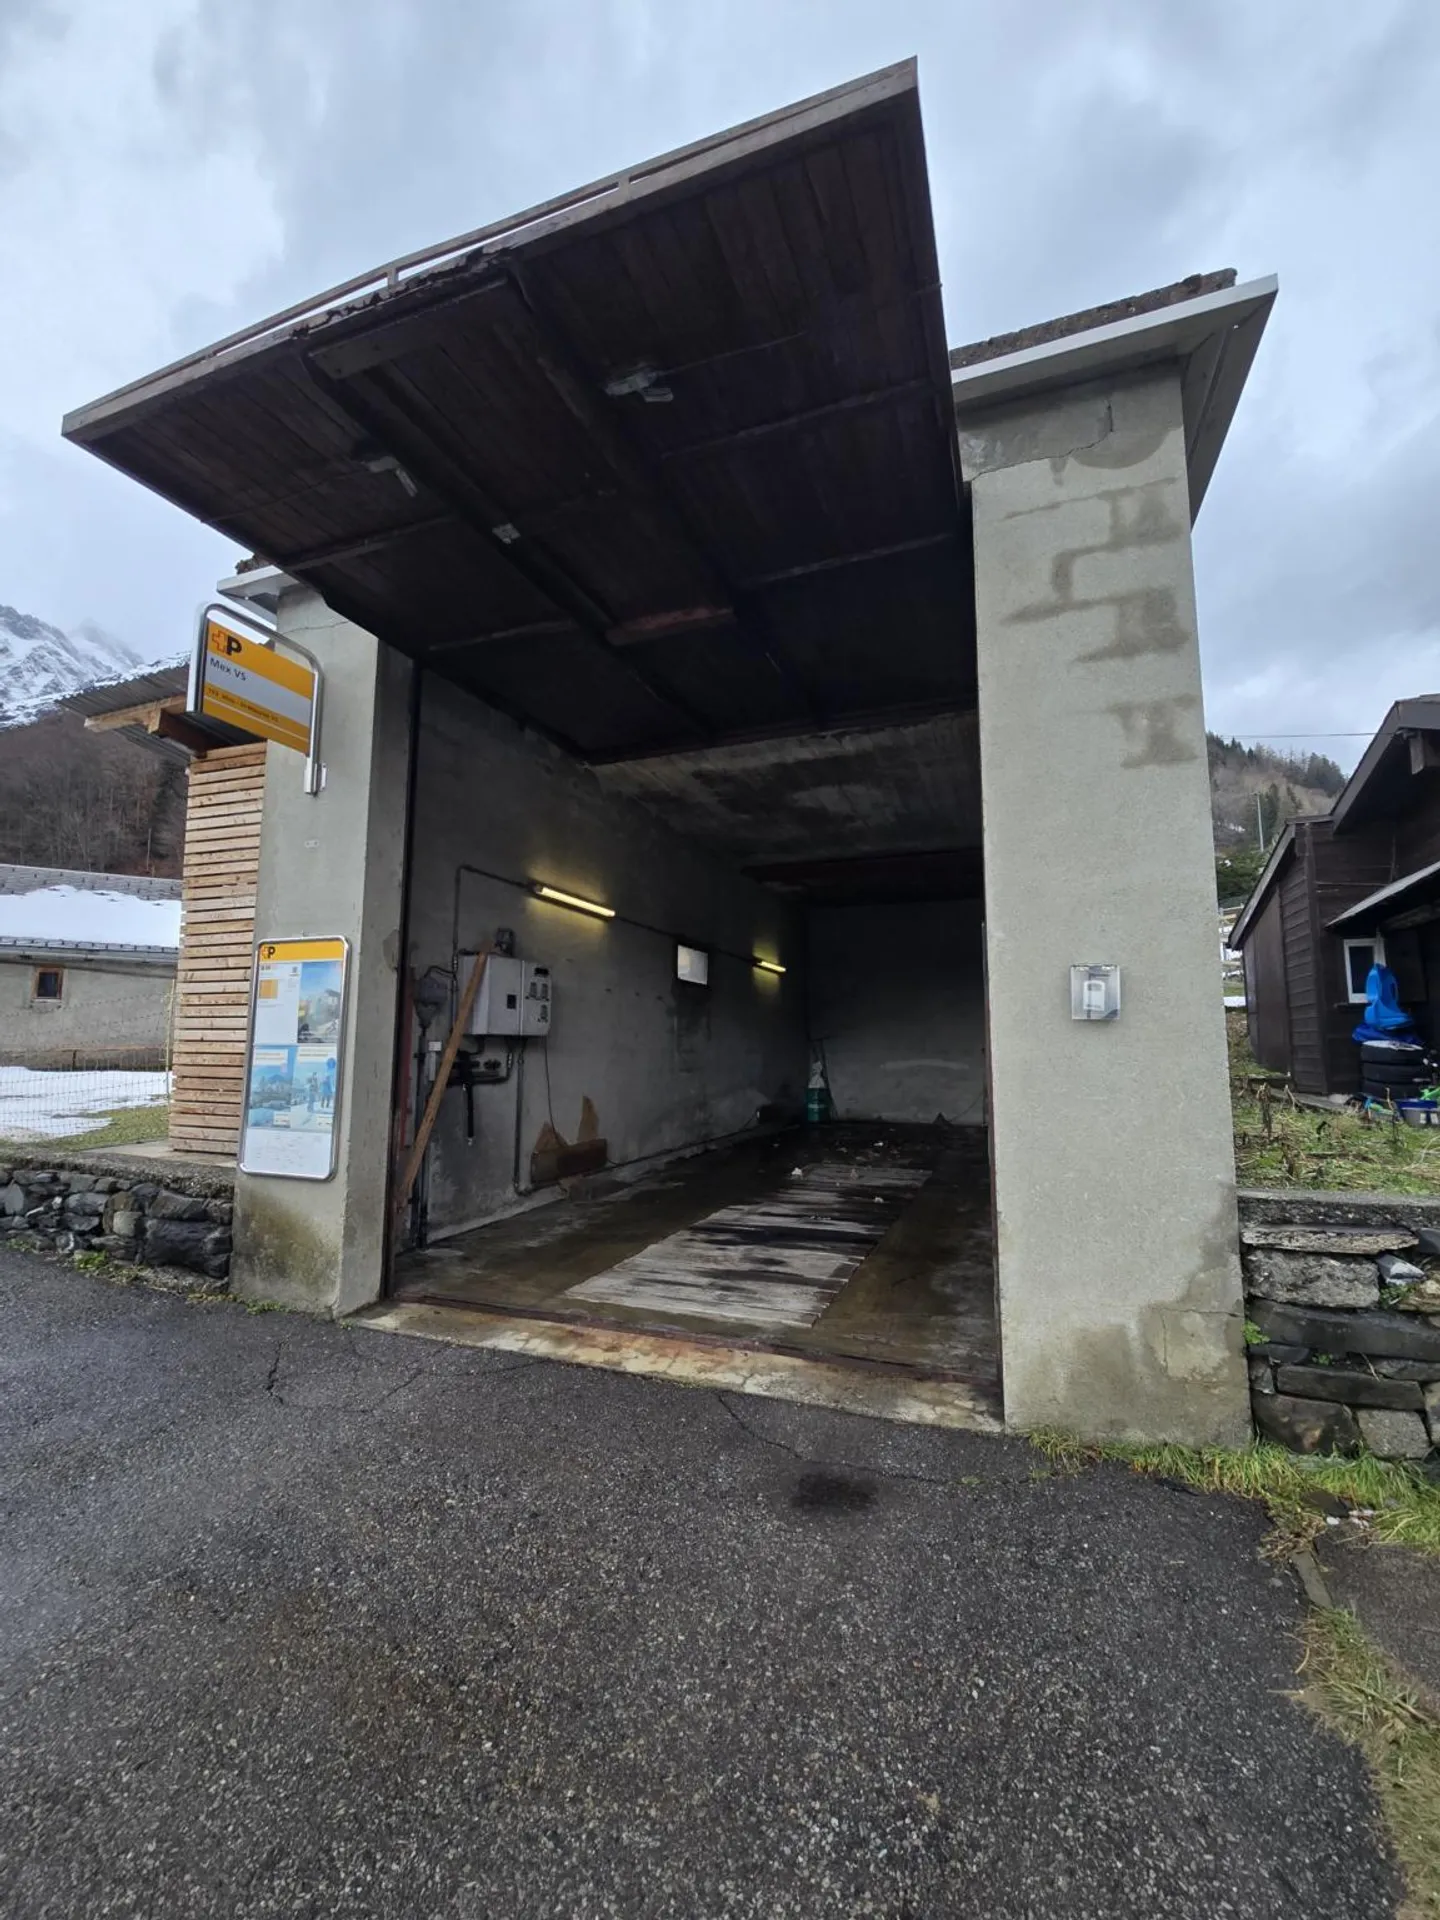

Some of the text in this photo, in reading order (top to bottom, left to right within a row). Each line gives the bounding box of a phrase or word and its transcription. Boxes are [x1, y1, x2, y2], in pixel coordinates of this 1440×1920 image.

[226, 635, 243, 656] P
[210, 657, 246, 681] Mex VS
[267, 946, 276, 959] P
